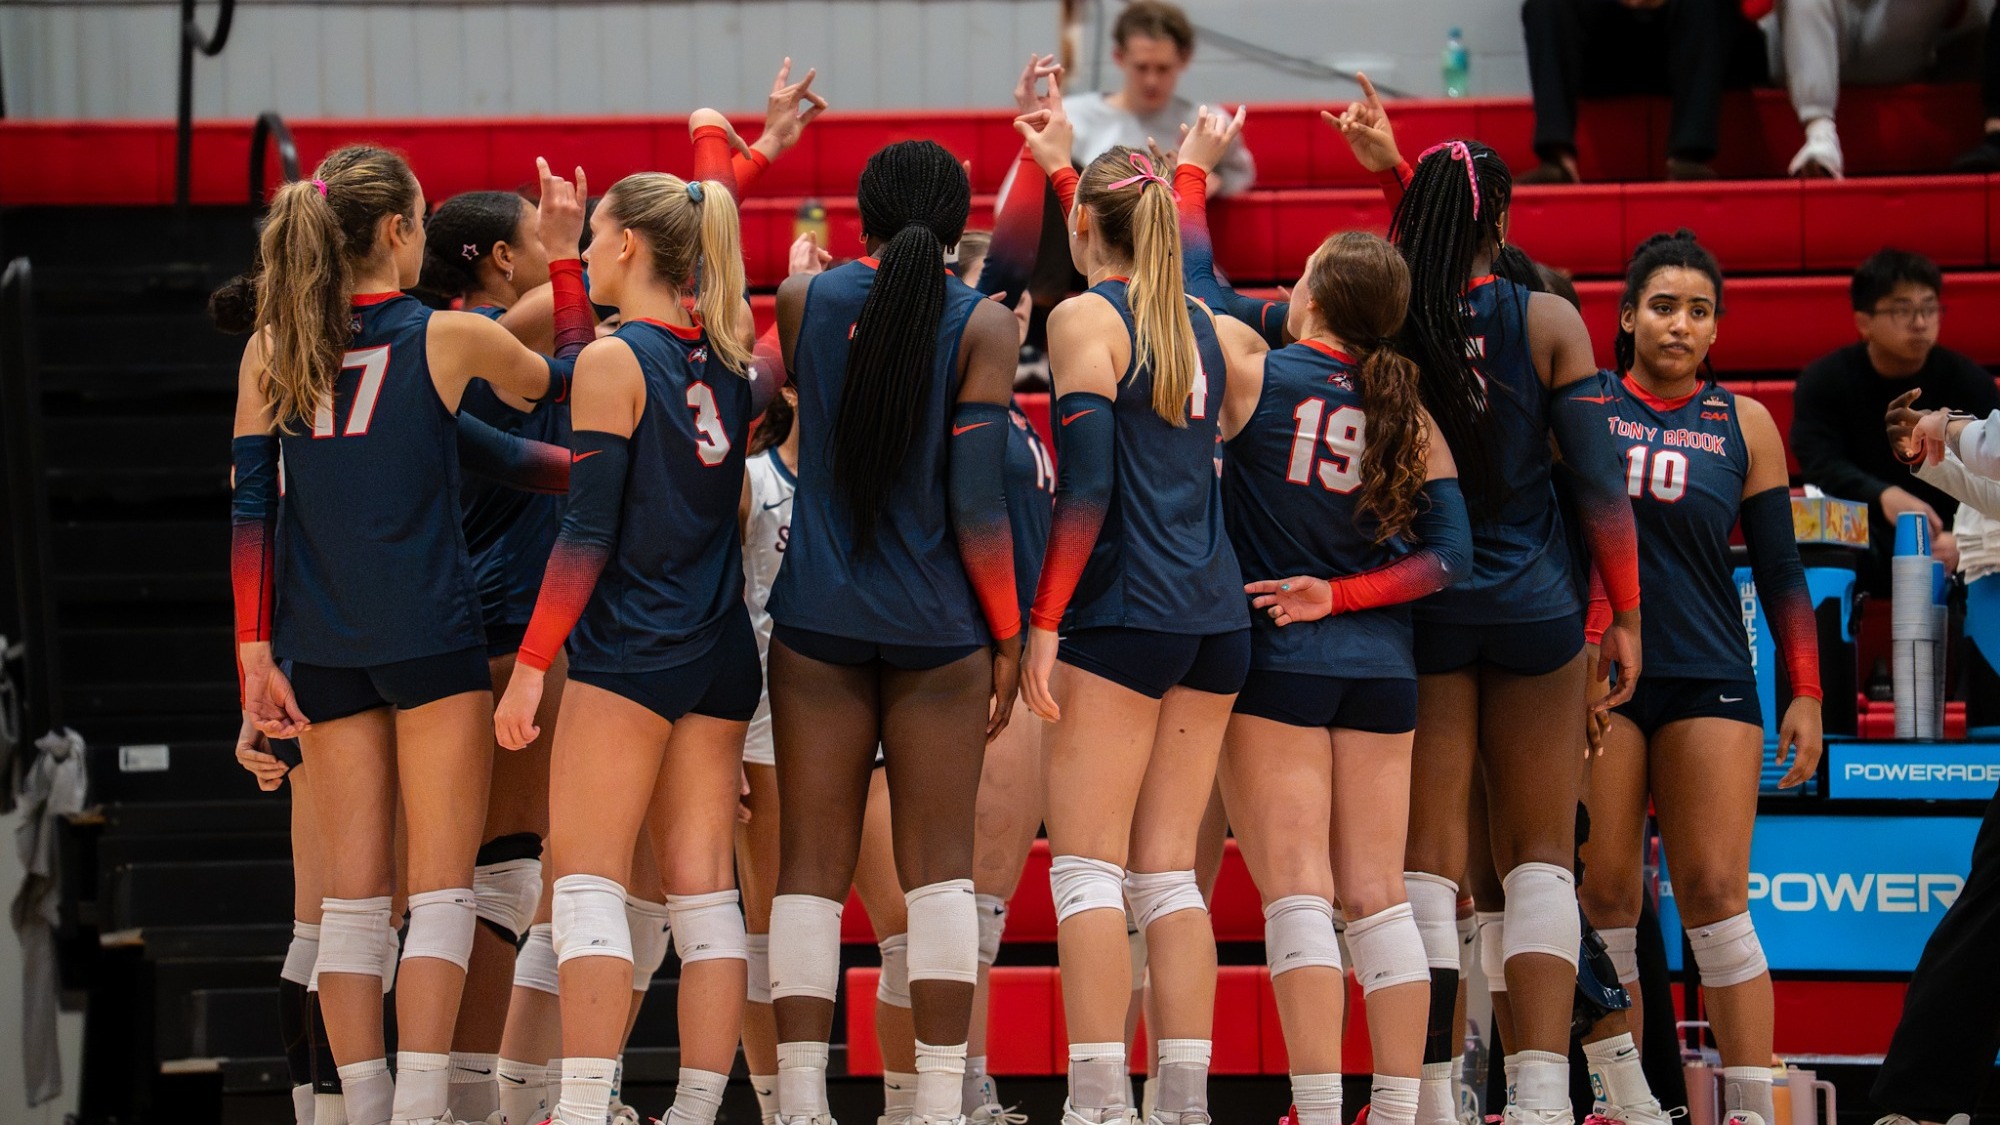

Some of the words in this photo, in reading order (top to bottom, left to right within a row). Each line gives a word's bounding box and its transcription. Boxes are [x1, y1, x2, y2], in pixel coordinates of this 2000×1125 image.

[686, 380, 732, 468] 3
[1286, 396, 1367, 496] 19
[1607, 416, 1658, 442] TONY
[1663, 428, 1726, 456] BROOK
[1626, 444, 1689, 504] 10
[775, 524, 790, 553] S
[1844, 763, 2000, 782] POWERADE
